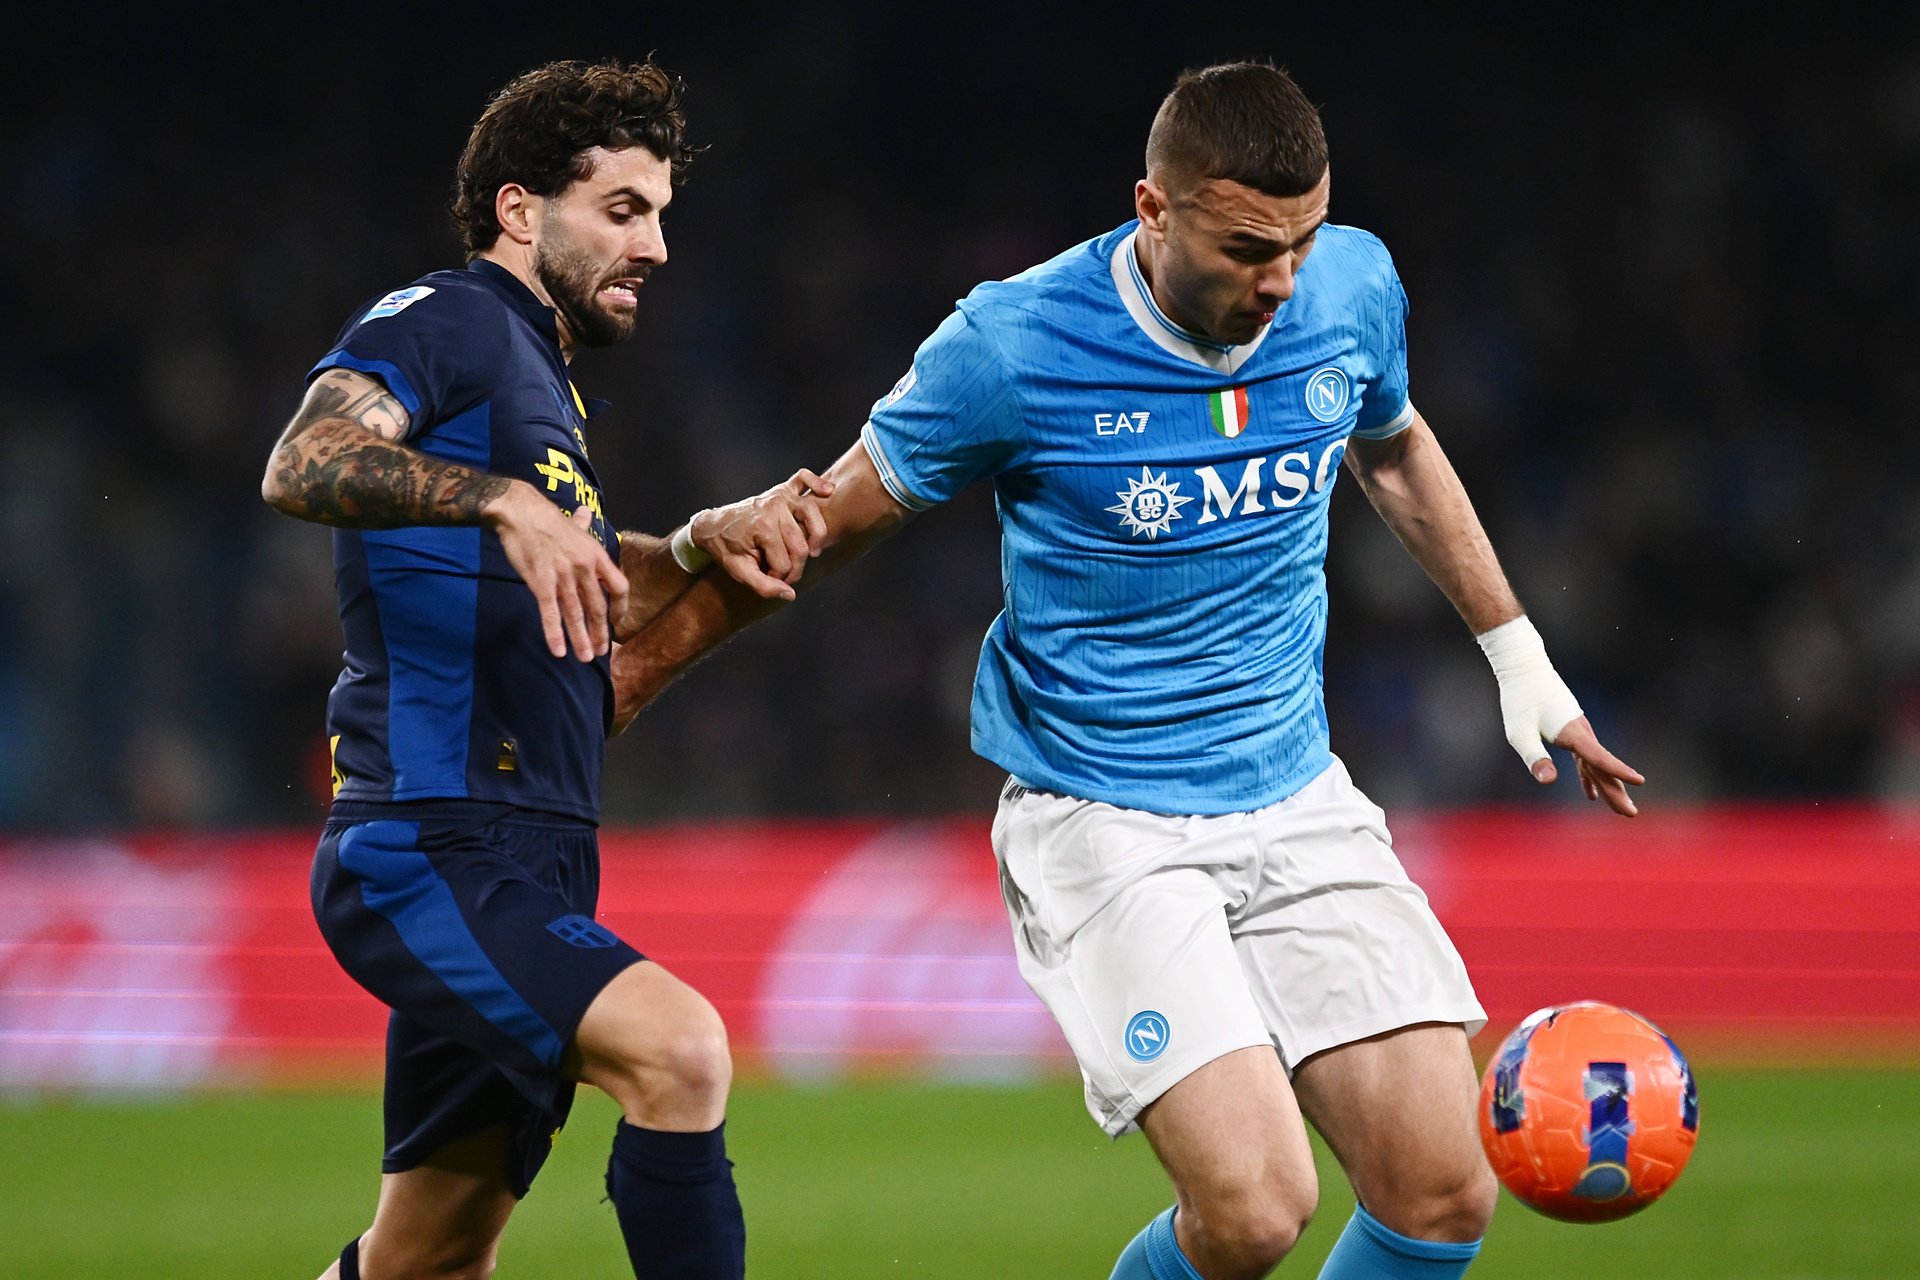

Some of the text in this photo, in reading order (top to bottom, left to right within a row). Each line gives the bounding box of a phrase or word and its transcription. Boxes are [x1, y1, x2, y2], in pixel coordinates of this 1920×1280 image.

[1317, 381, 1336, 409] N
[1094, 411, 1151, 436] EA7
[1134, 1020, 1161, 1052] N
